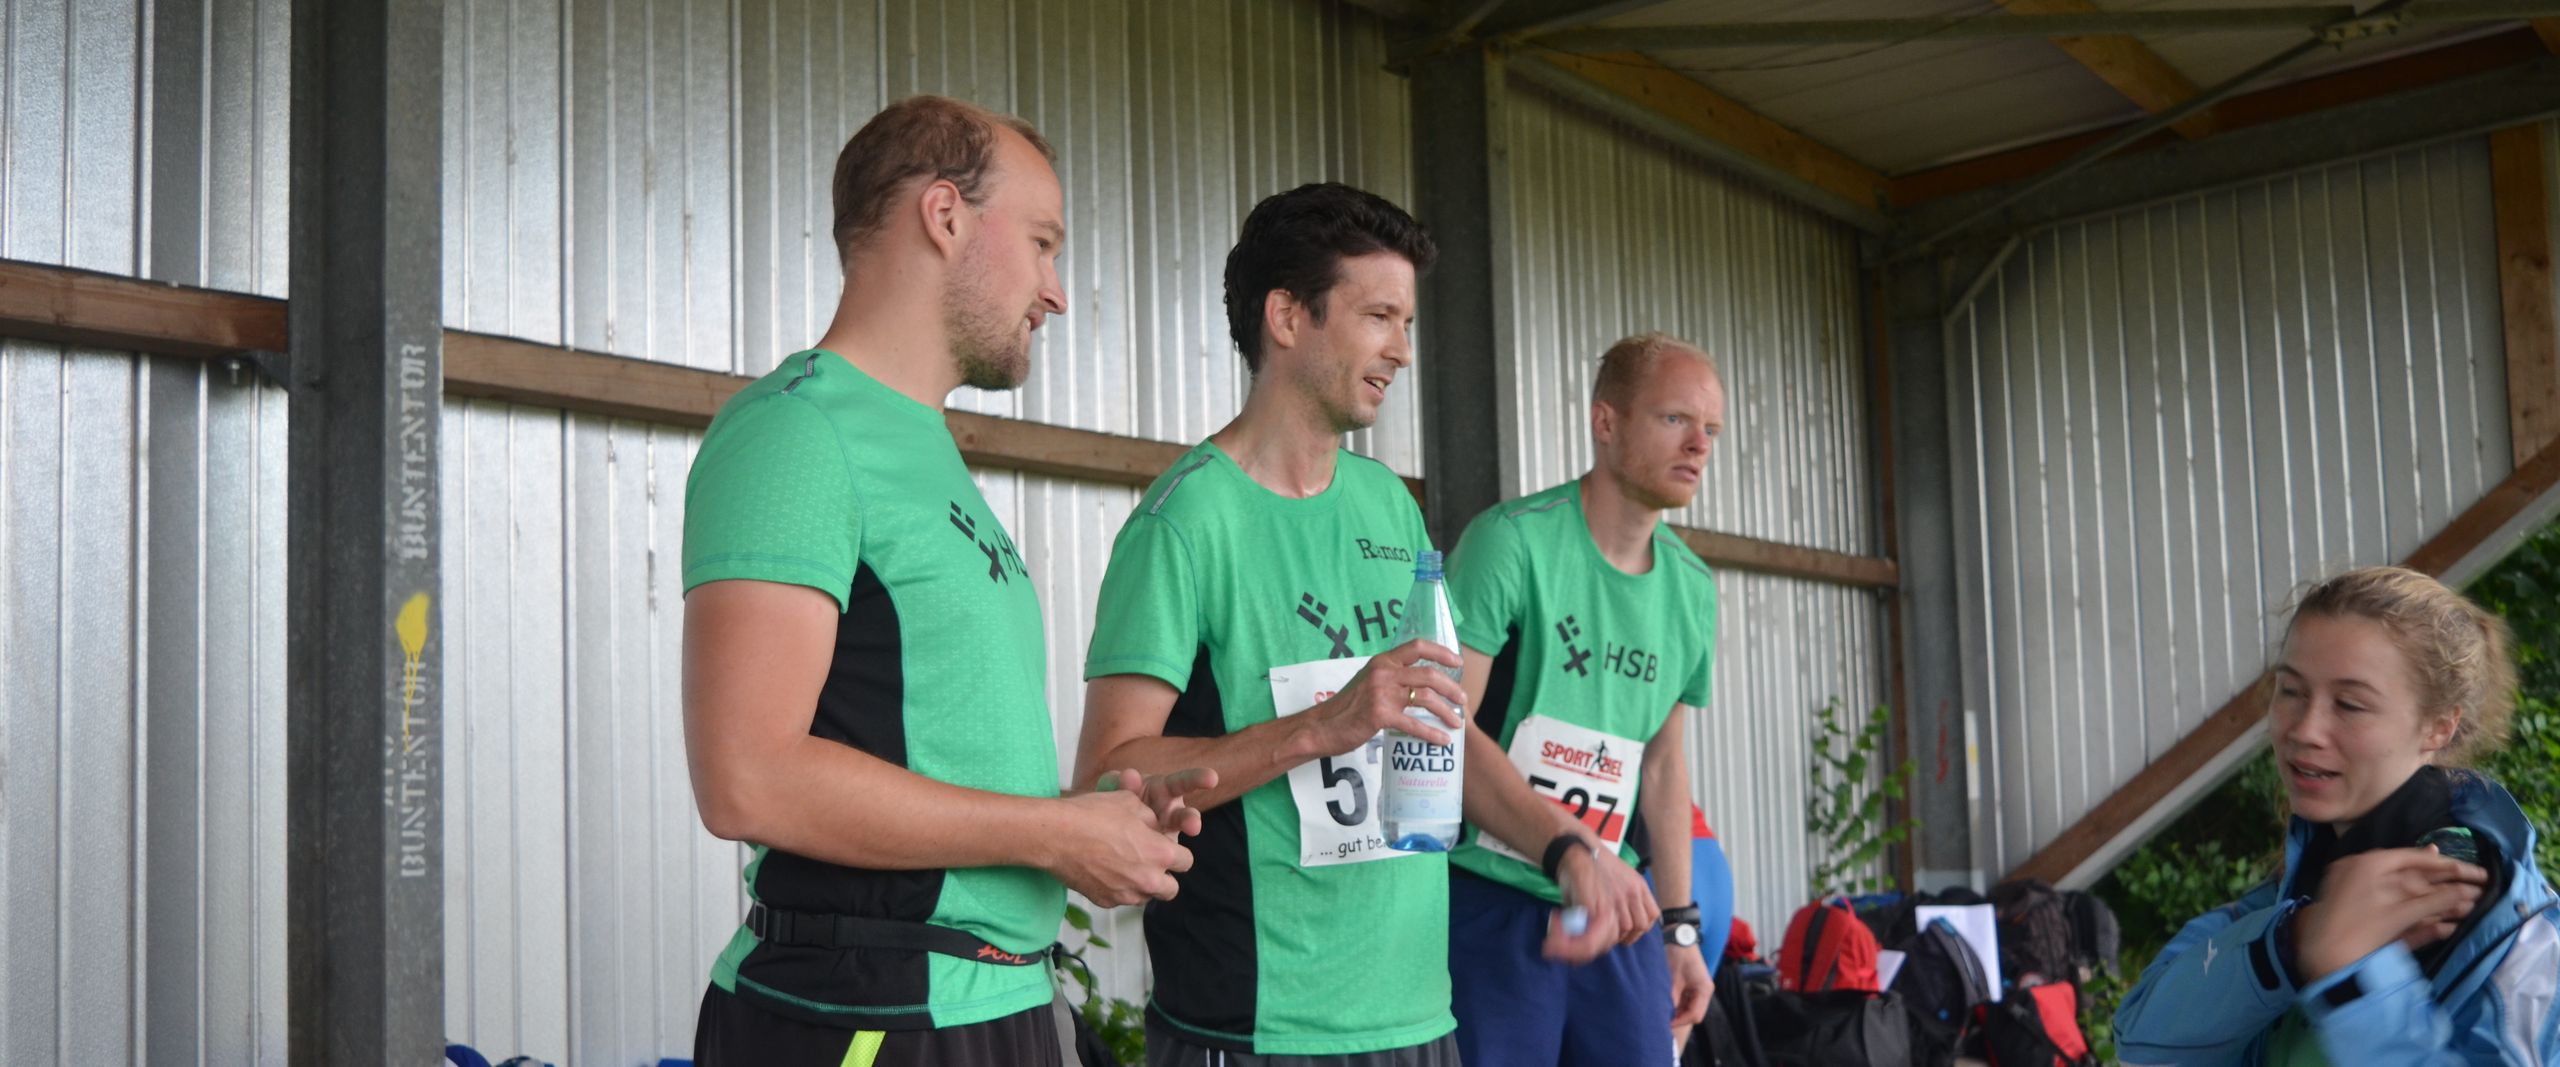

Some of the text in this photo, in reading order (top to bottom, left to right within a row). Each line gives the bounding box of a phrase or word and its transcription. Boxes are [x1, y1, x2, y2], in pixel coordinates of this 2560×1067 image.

[400, 343, 428, 560] BUNTENTOR
[1353, 598, 1404, 642] HS
[1603, 640, 1659, 682] HSB
[1392, 740, 1455, 757] AUEN
[1392, 756, 1456, 773] WALD
[1541, 740, 1594, 769] SPORT
[401, 660, 427, 877] BUNTENTOR
[1338, 837, 1363, 858] gut
[1366, 834, 1387, 851] be
